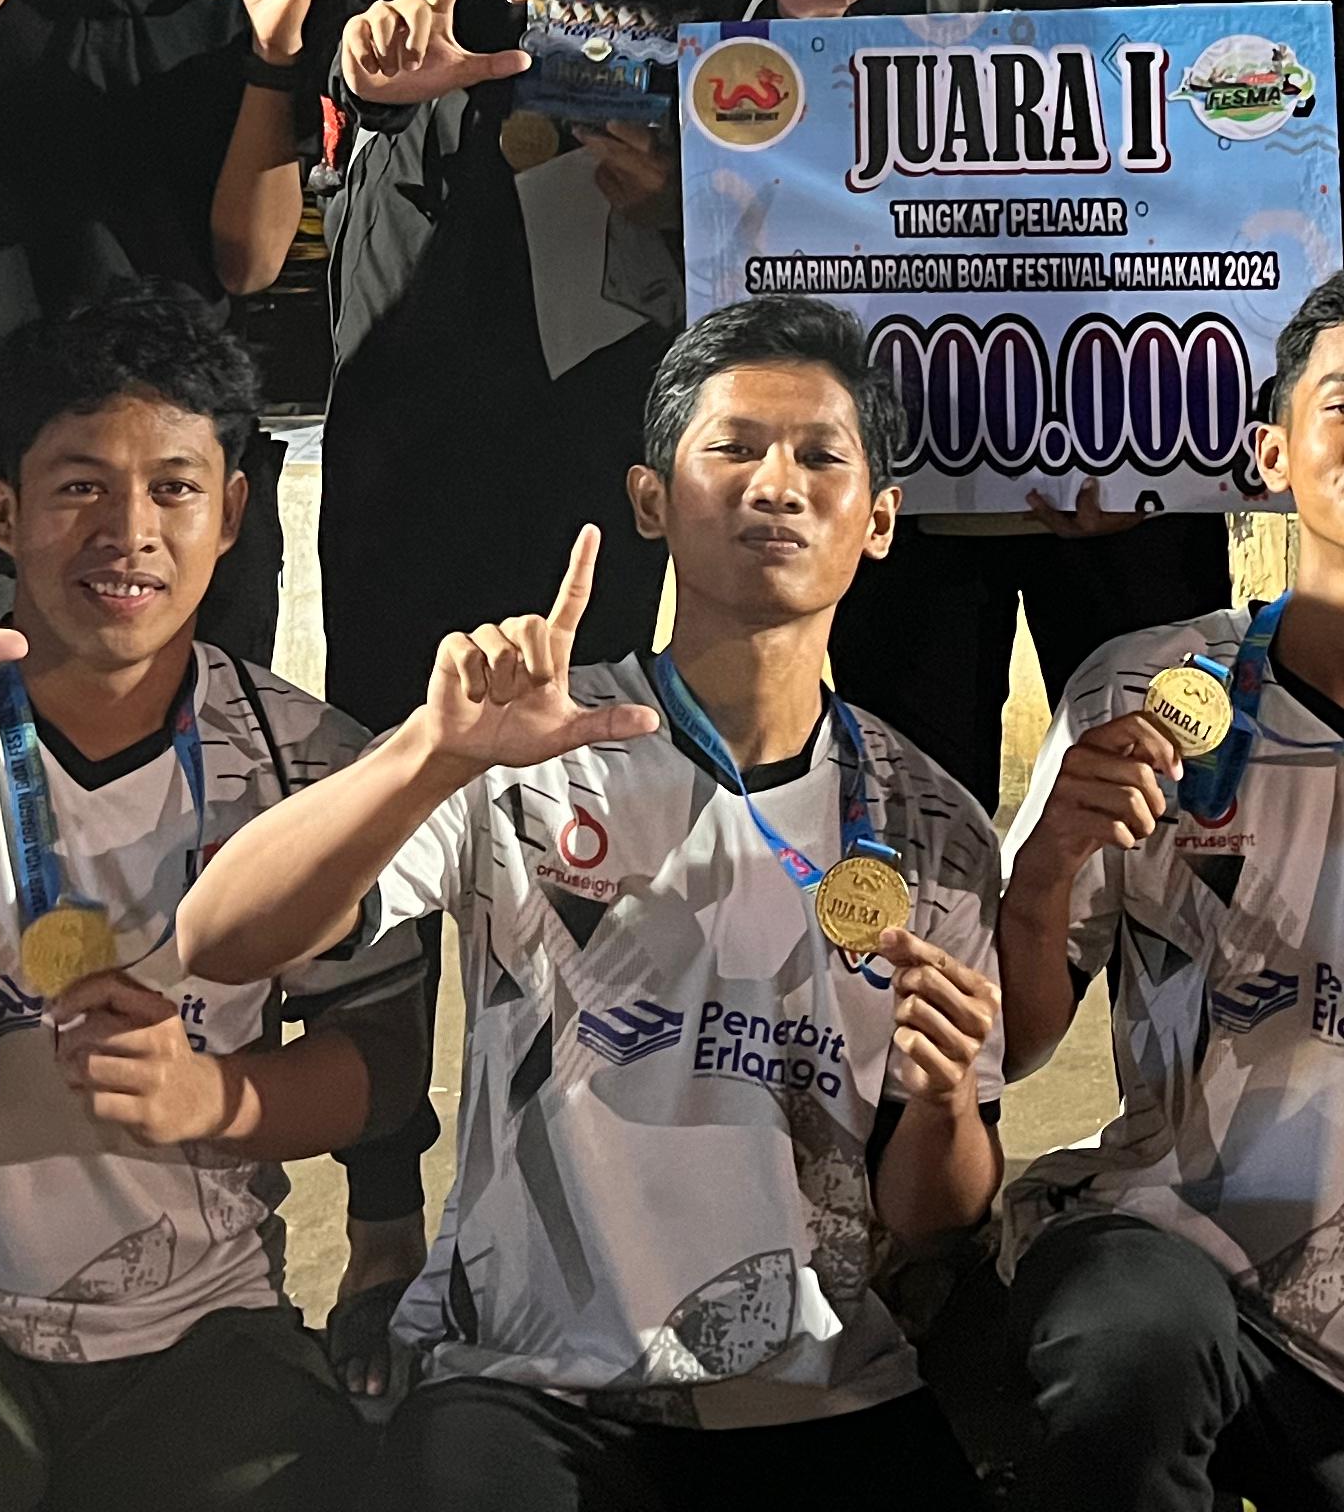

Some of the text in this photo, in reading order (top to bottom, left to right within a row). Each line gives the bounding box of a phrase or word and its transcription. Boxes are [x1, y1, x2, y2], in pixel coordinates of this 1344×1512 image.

[1205, 85, 1283, 110] FESMA
[854, 48, 1163, 186] JUARA I
[894, 200, 1126, 236] TINGKAT PELAJAR
[749, 253, 1277, 291] SAMARINDA DRAGON BOAT FESTIVAL MAHAKAM 2024
[1153, 699, 1212, 741] JUARA I
[10, 758, 30, 790] BOAT
[15, 791, 38, 844] DRAGON
[1174, 833, 1256, 853] ortuseight
[22, 845, 48, 914] AMARINDA
[826, 898, 880, 926] JUARA
